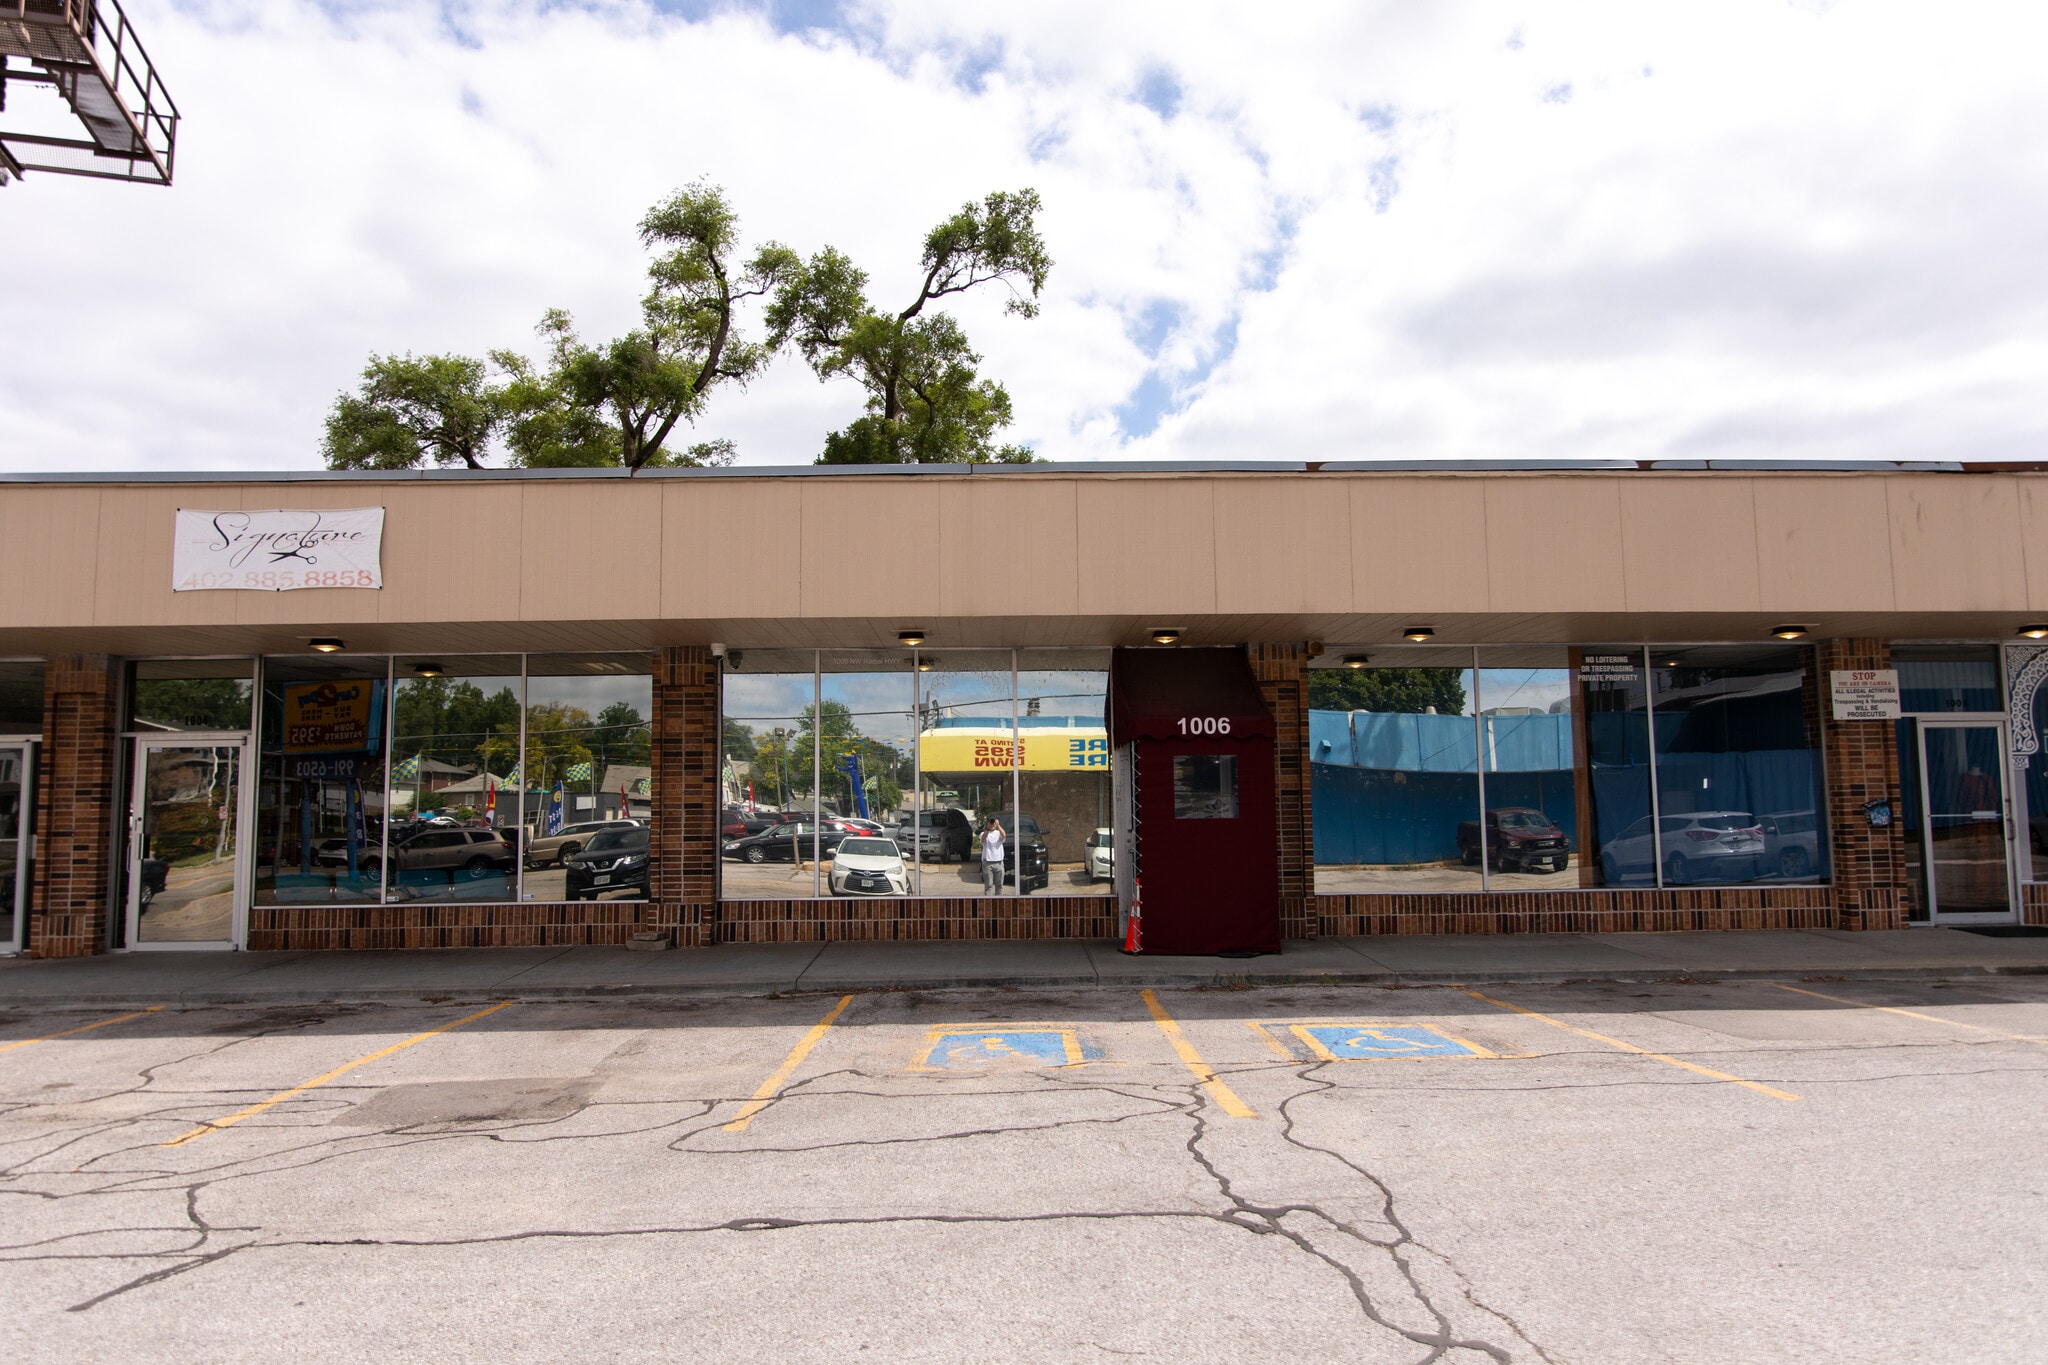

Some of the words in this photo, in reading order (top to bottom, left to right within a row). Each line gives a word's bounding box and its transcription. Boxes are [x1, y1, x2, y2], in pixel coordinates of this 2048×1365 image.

[209, 511, 364, 569] Signature
[182, 570, 373, 588] 402.885.8858
[884, 656, 901, 665] HWY
[1581, 665, 1590, 673] OR
[1577, 674, 1604, 682] PRIVATE
[1852, 671, 1876, 681] STOP
[185, 715, 208, 726] 1004
[1177, 717, 1231, 735] 1006
